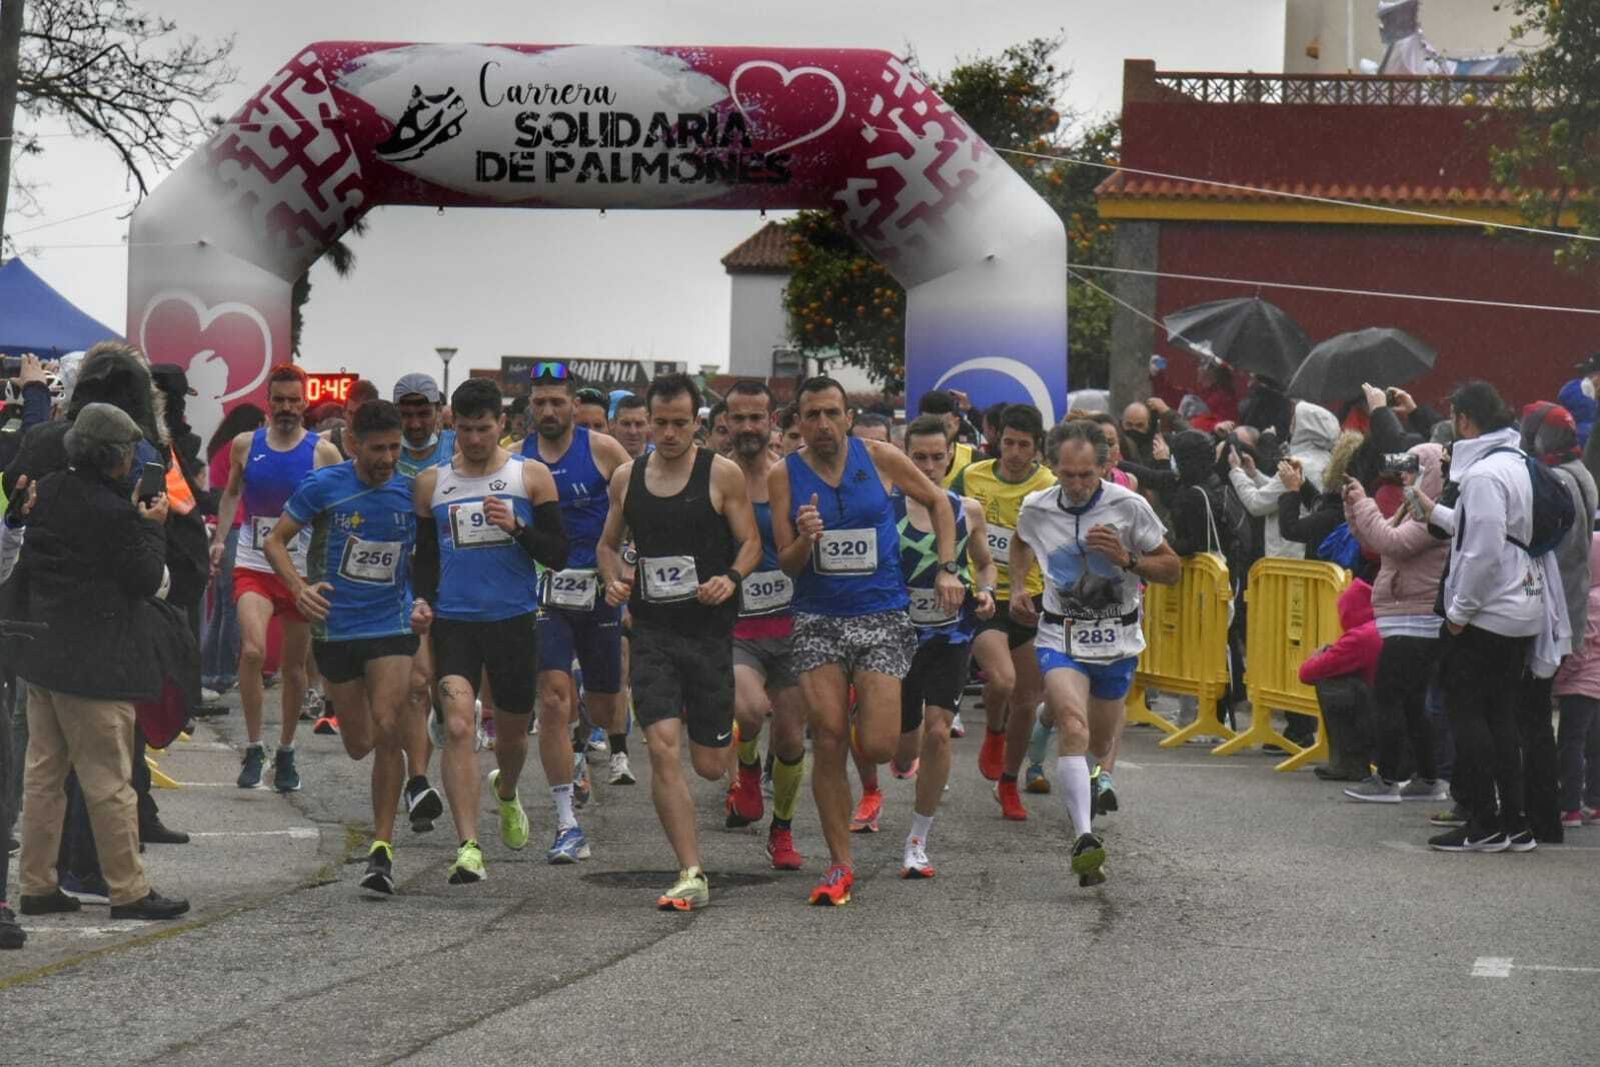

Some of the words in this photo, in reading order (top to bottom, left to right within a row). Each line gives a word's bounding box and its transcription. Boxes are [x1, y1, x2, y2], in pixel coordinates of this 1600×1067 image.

[480, 61, 617, 107] Carrera
[514, 111, 752, 149] SOLIDARIA
[476, 151, 537, 183] DE
[546, 151, 792, 185] PALMONES
[568, 360, 638, 383] BOHEMIA
[827, 540, 868, 556] 320
[355, 551, 393, 567] 256
[655, 566, 681, 583] 12
[554, 577, 588, 592] 224
[749, 579, 785, 597] 305
[1077, 628, 1116, 644] 283
